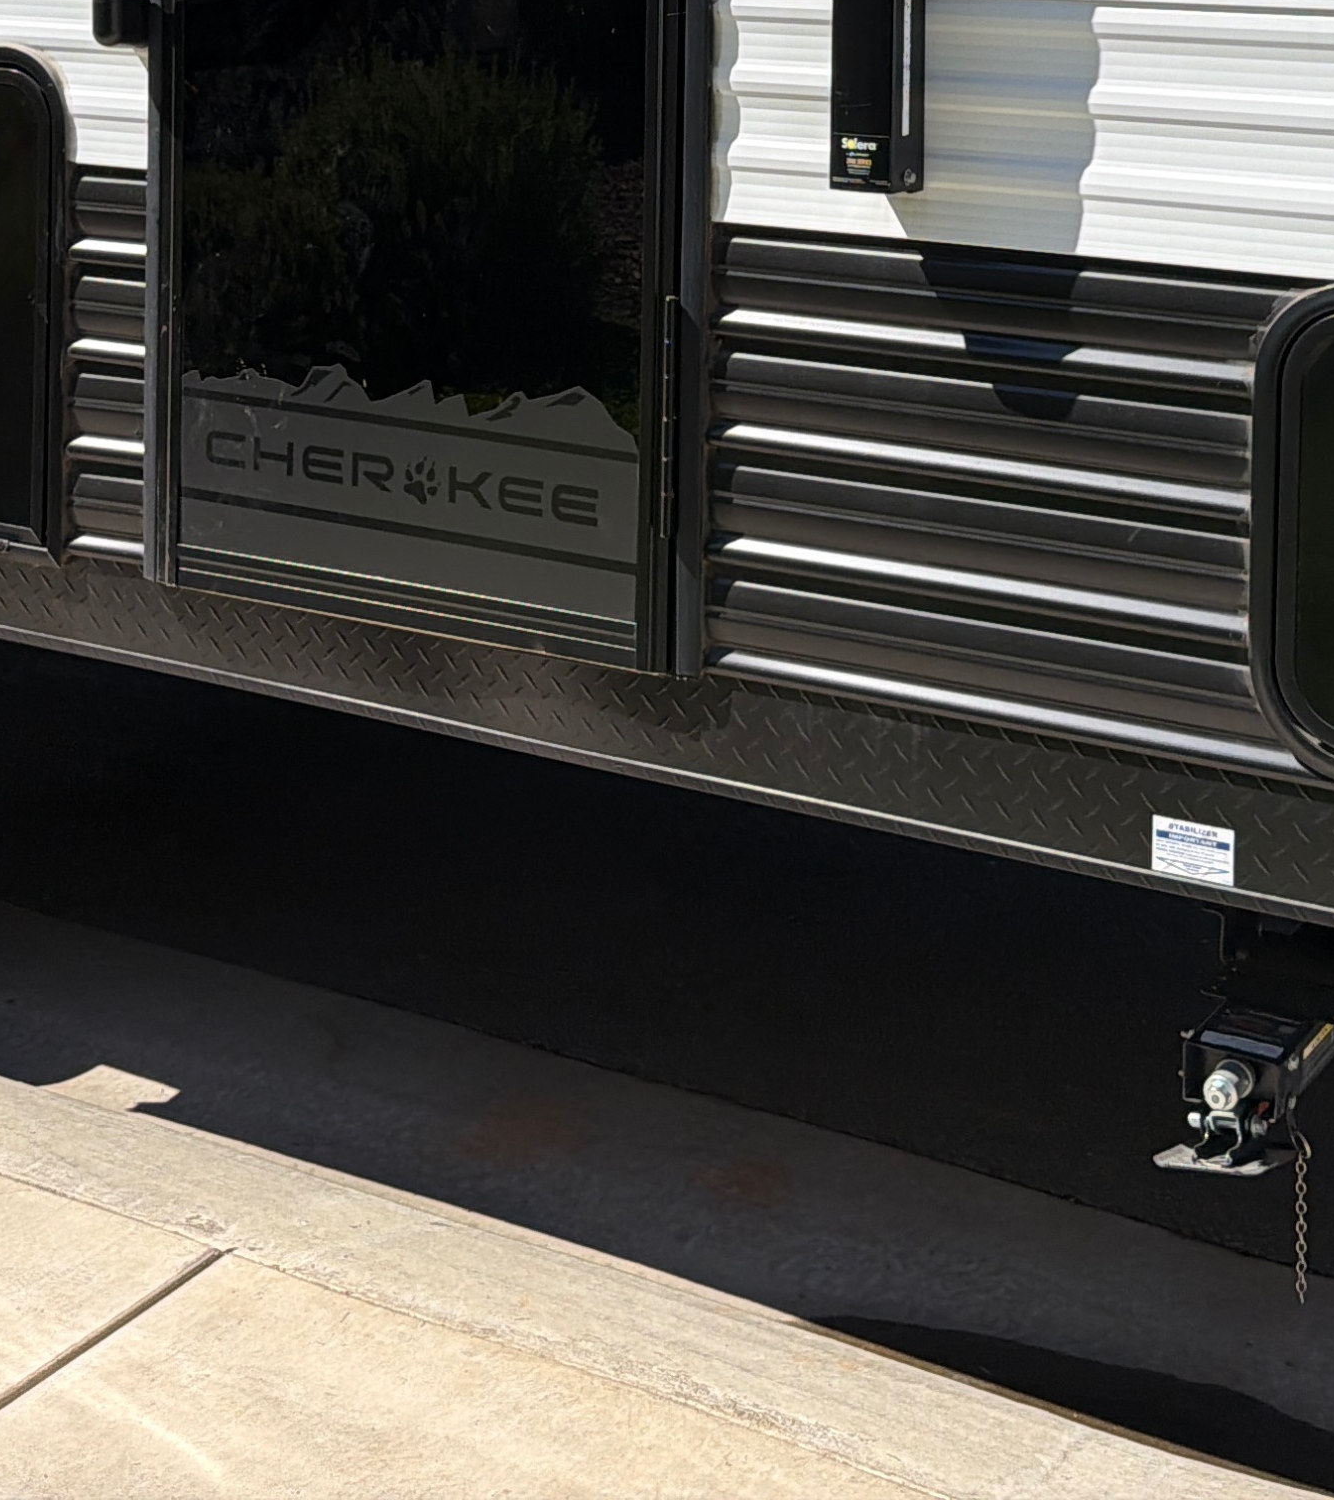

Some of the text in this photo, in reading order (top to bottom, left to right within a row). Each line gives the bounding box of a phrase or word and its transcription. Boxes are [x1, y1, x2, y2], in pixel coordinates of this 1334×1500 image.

[841, 137, 877, 151] Solera
[205, 430, 599, 527] CHERKEE
[1168, 822, 1219, 838] STABILIZER
[1168, 832, 1218, 848] IMPORTANT
